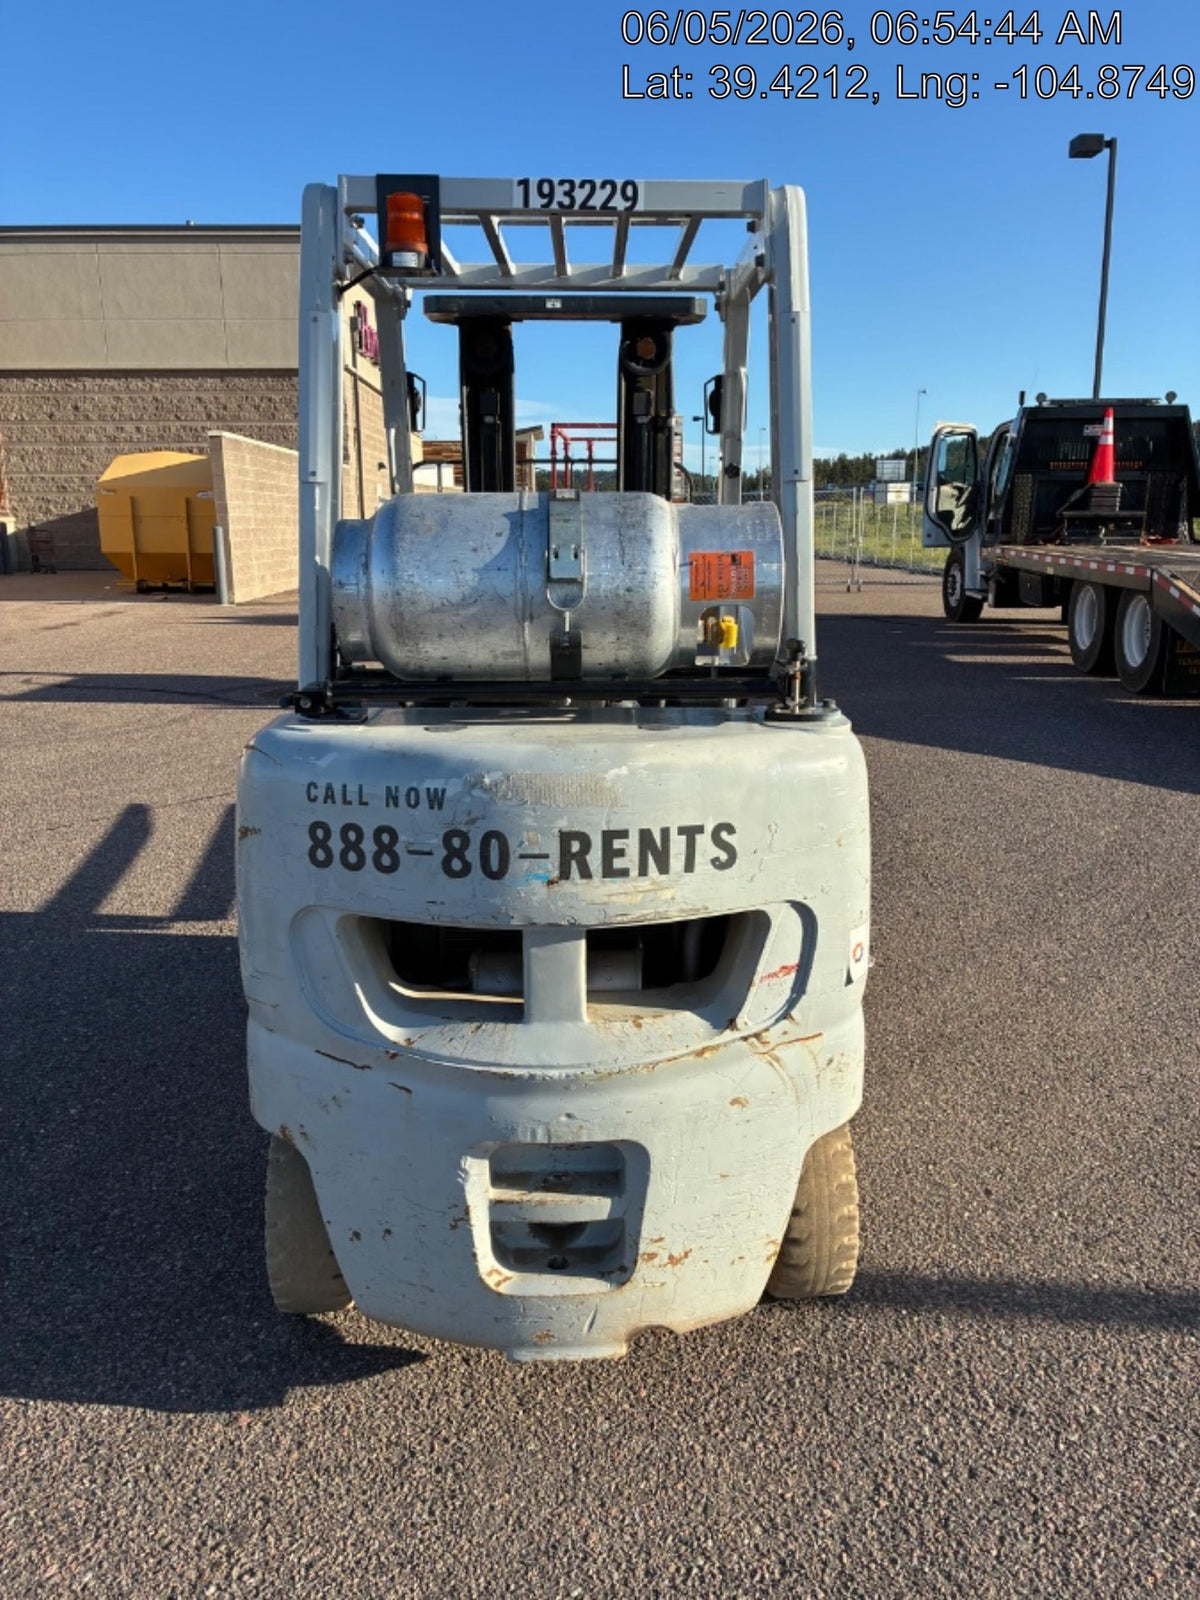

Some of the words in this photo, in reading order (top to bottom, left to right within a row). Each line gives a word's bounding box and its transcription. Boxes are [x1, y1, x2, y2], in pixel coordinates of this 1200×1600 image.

[517, 177, 639, 211] 193229
[306, 781, 369, 806] CALL
[385, 785, 446, 811] NOW
